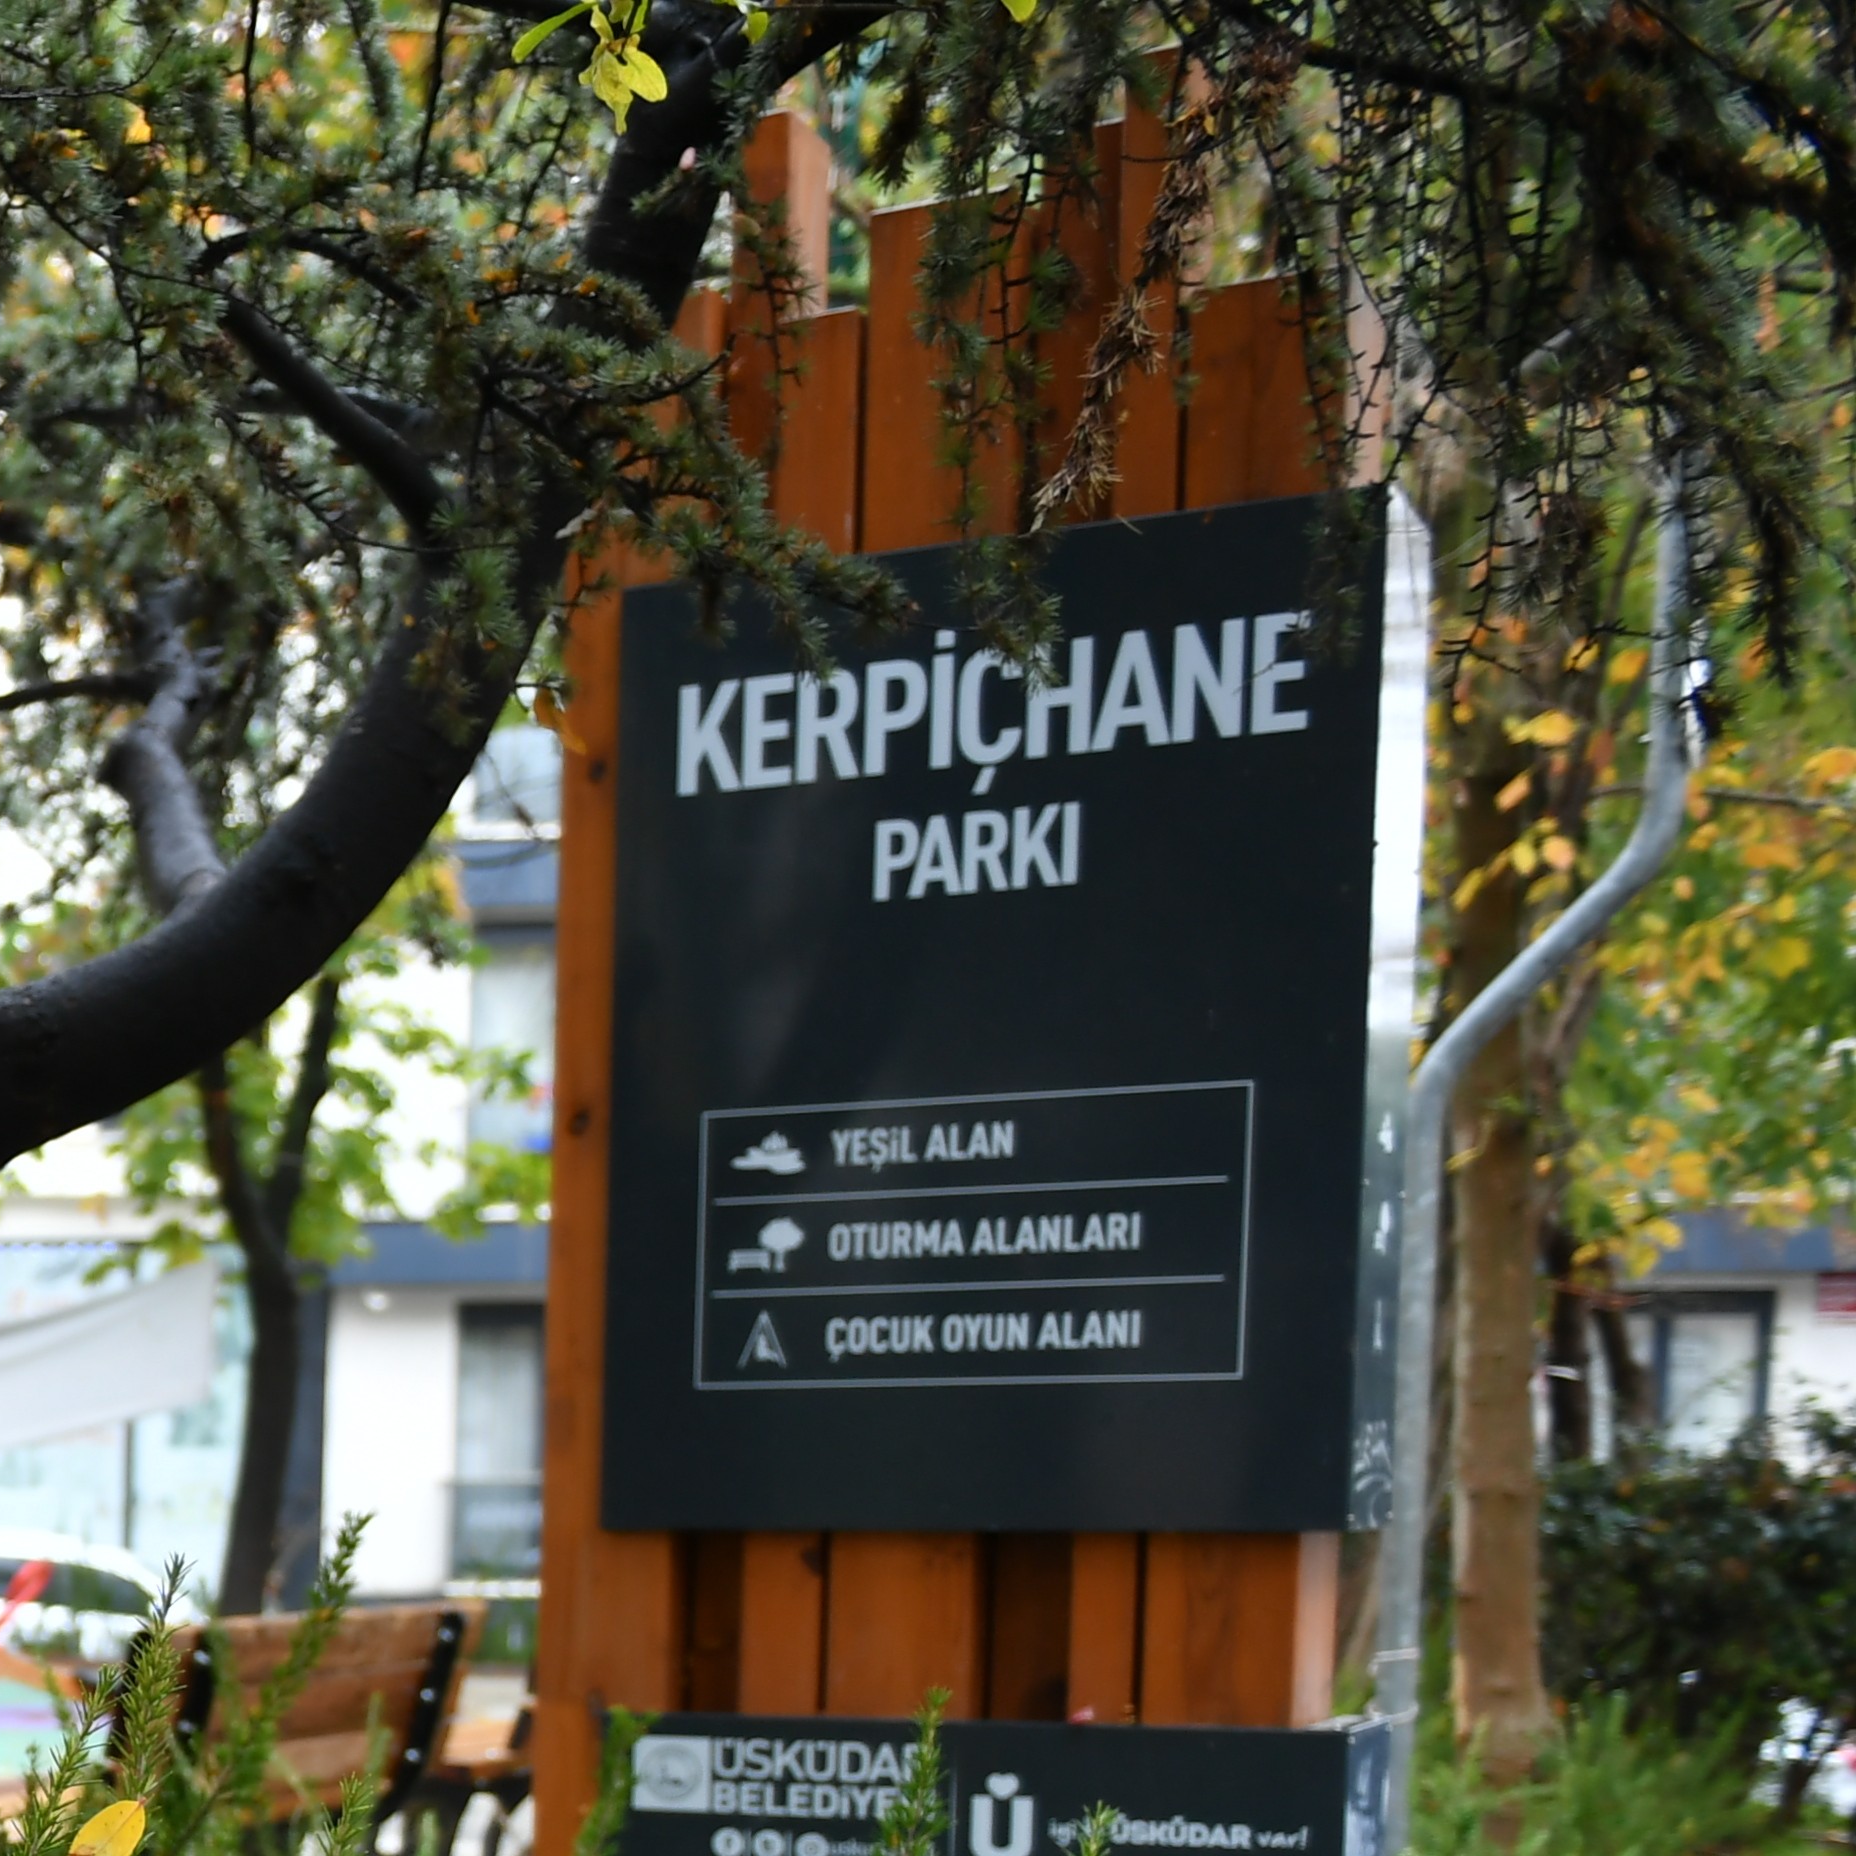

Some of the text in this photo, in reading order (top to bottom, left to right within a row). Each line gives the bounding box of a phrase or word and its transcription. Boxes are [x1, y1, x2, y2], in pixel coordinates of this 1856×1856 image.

[677, 611, 1311, 796] KERPİÇHANE
[873, 801, 1081, 902] PARKI
[830, 1120, 1015, 1172] YEŞİL ALAN
[827, 1211, 1141, 1261] OTURMA ALANLARI
[825, 1309, 1142, 1361] ÇOCUK OYUN ALANI
[1110, 1812, 1252, 1850] ÜSKÜDAR
